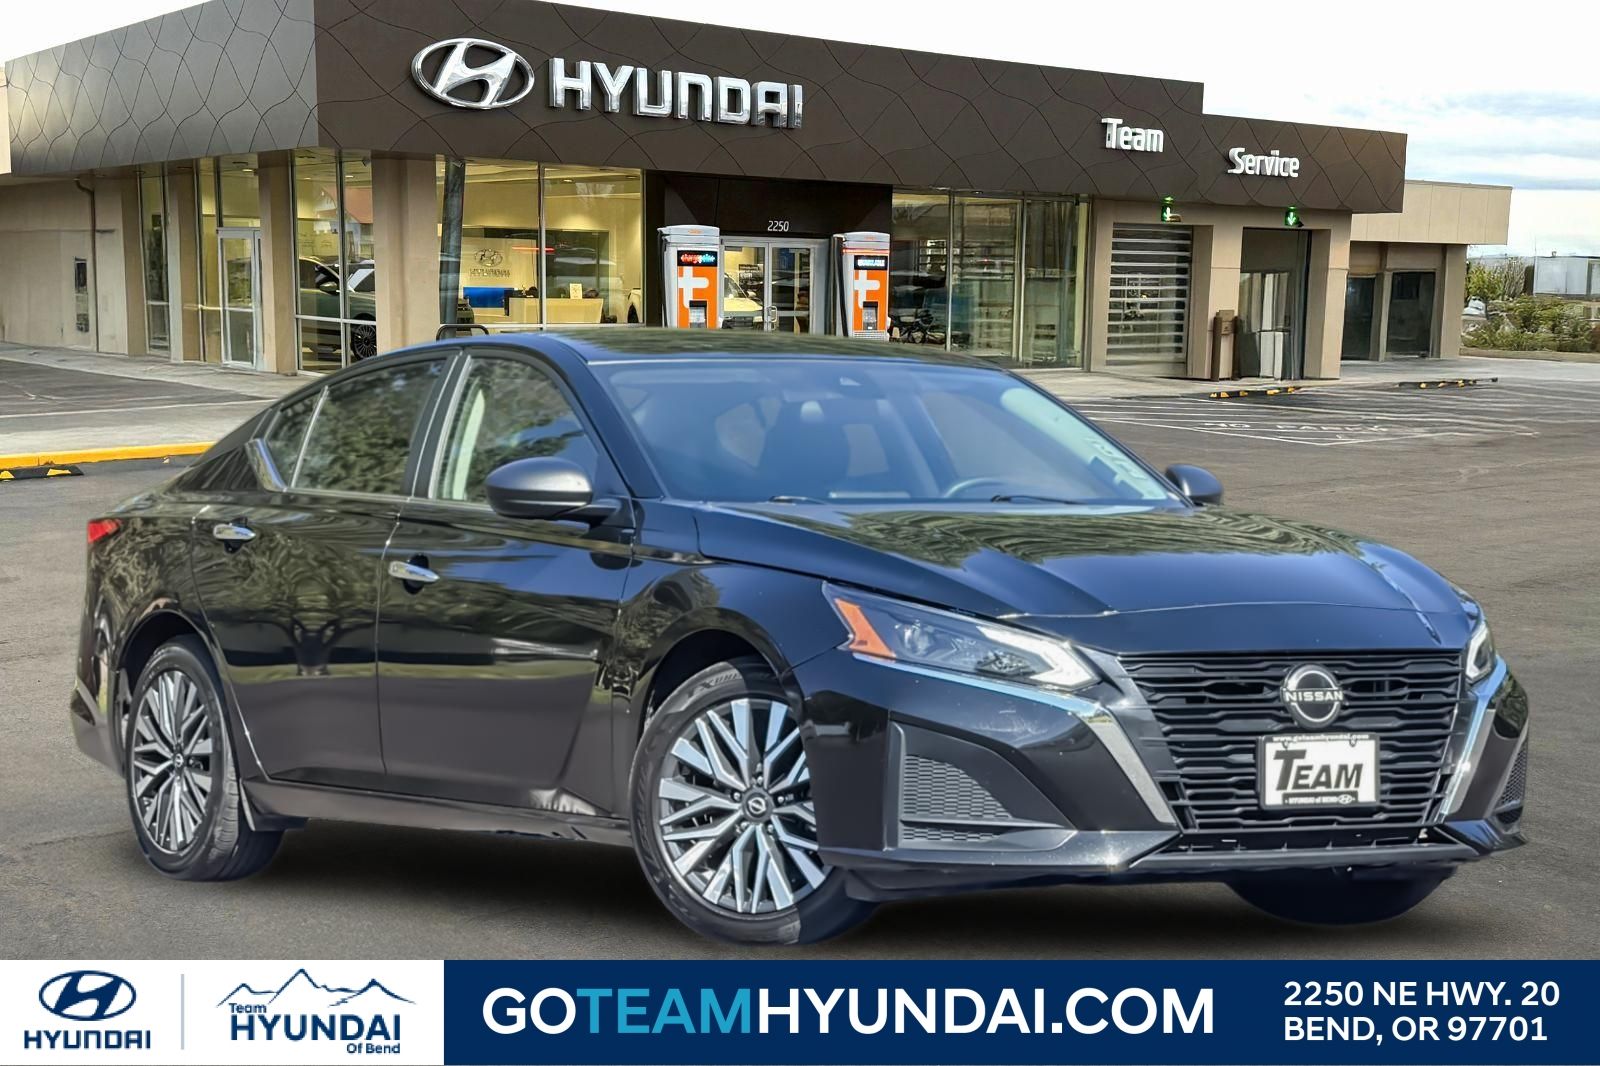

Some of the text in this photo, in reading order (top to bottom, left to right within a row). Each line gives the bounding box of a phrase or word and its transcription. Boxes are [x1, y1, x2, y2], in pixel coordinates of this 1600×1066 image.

[548, 57, 805, 129] HYUNDAI
[1100, 117, 1165, 153] Team
[1227, 146, 1301, 178] Service
[767, 220, 790, 232] 2250
[1285, 690, 1344, 703] NISSAN
[1273, 749, 1364, 791] TEAM
